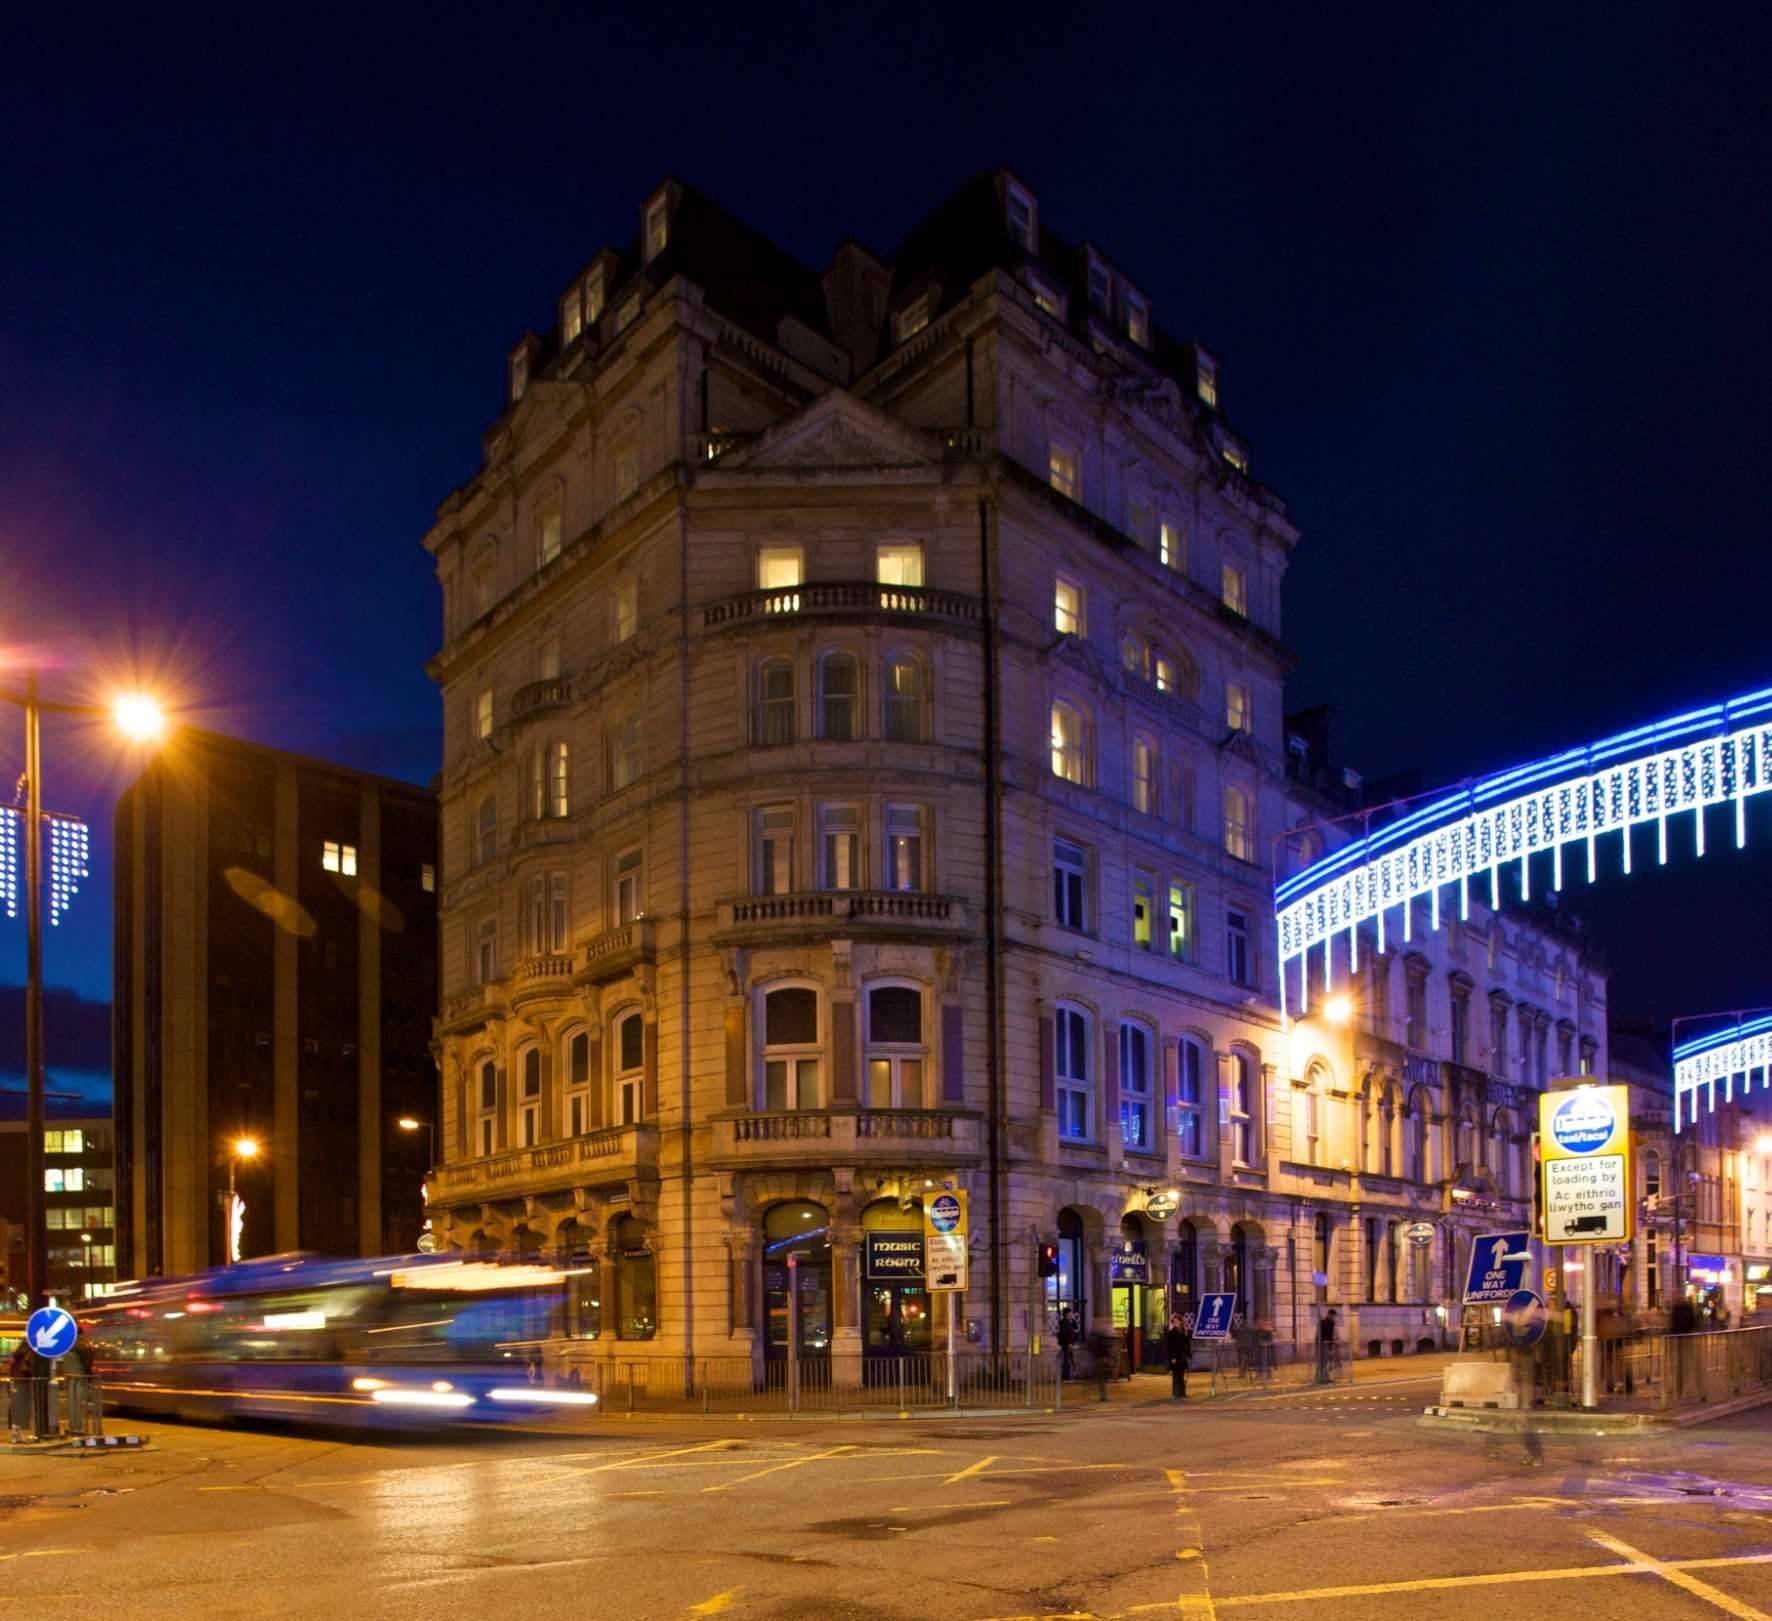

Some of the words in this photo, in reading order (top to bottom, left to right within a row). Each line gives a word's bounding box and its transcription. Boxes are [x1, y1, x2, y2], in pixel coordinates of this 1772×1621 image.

[1552, 1161, 1593, 1174] Except
[1600, 1160, 1617, 1169] for
[1552, 1173, 1597, 1186] loading
[1602, 1173, 1616, 1183] by
[1554, 1191, 1570, 1200] Ac
[1576, 1189, 1616, 1199] eithrio
[1549, 1202, 1594, 1213] llwytho
[1600, 1201, 1622, 1211] gan
[1485, 1270, 1507, 1280] ONE
[1482, 1280, 1506, 1289] WAY
